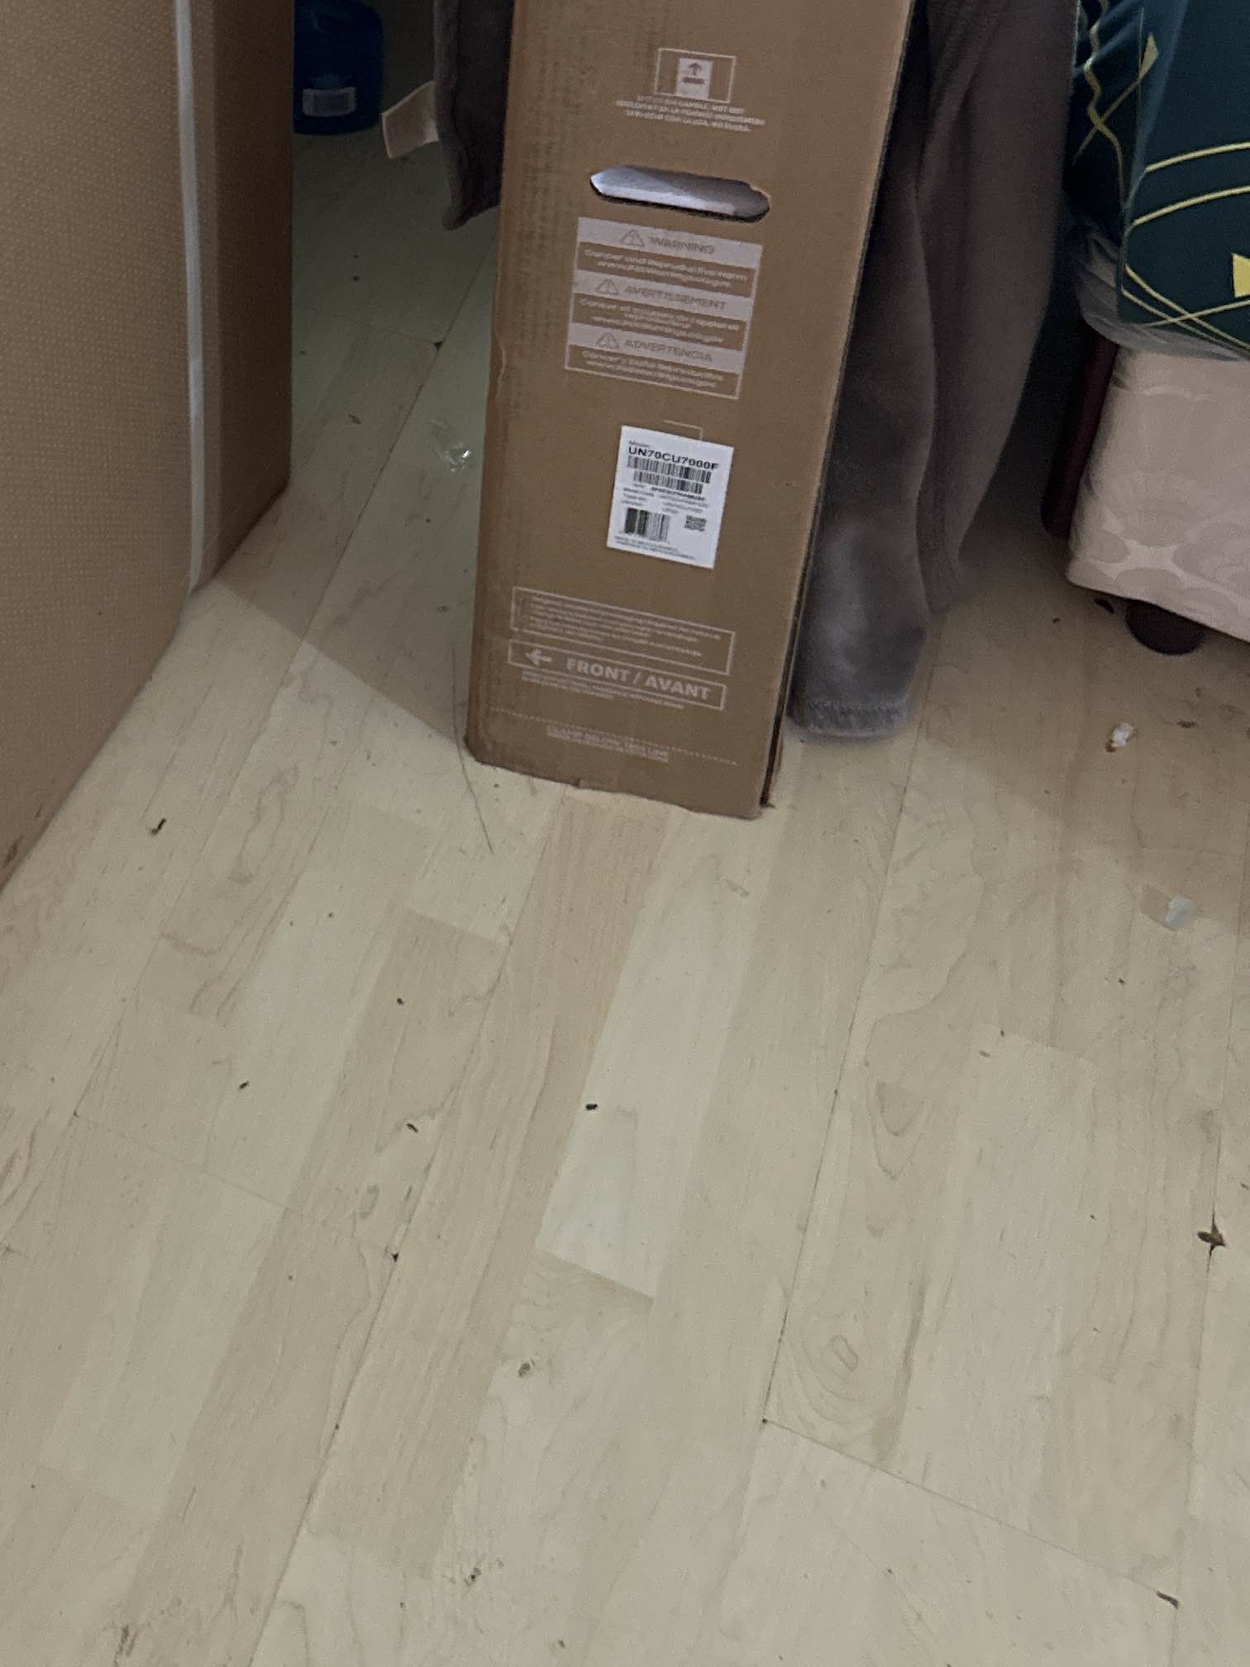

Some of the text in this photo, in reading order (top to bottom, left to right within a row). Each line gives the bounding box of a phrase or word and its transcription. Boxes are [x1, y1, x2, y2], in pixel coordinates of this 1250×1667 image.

[650, 237, 715, 255] WARNING
[624, 286, 727, 310] AVERTISSEMENT
[629, 446, 719, 471] UN70CU7000F
[566, 657, 630, 682] FRONT
[633, 672, 641, 684] /
[646, 675, 711, 700] AVANT
